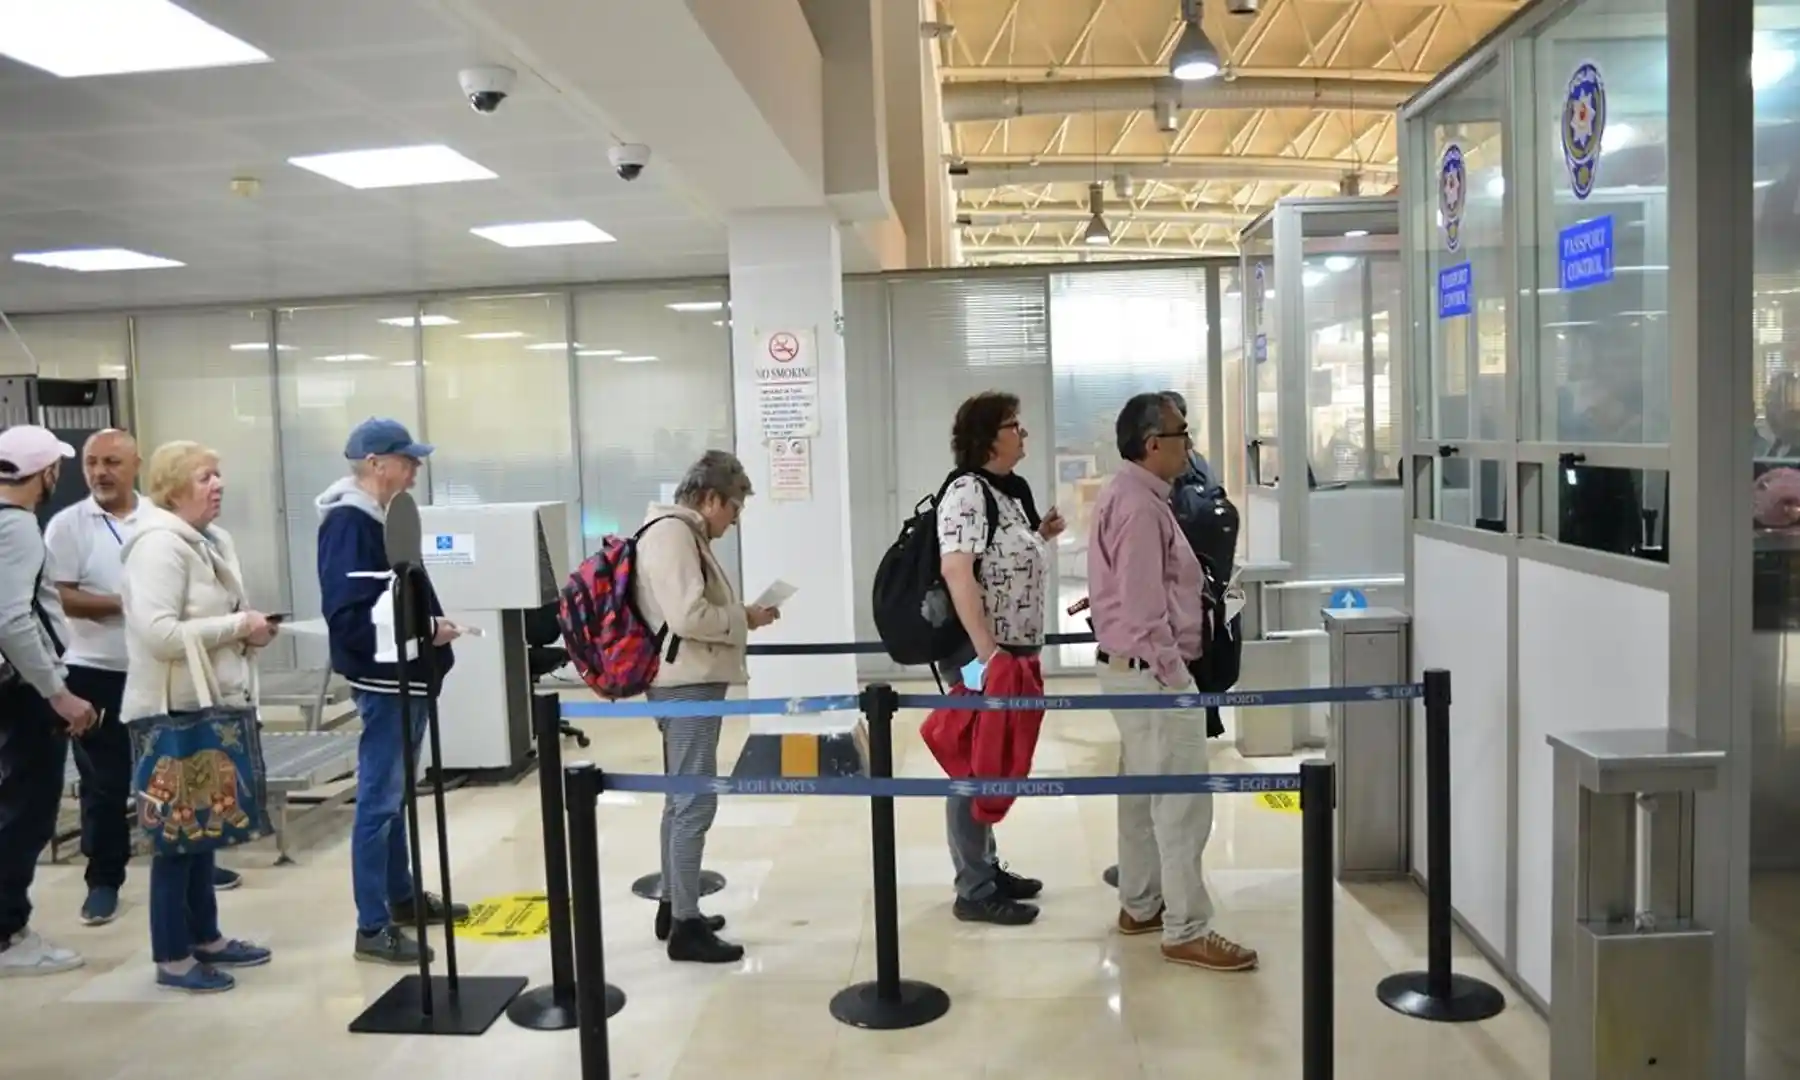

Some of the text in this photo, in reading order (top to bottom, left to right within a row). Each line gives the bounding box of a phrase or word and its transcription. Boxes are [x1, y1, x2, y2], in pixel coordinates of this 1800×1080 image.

[1563, 227, 1606, 258] PASSPORT
[1567, 254, 1604, 281] CONTROL
[756, 368, 770, 378] NO
[769, 779, 817, 793] PORTS
[1015, 781, 1065, 795] PORTS
[1240, 777, 1270, 792] EGE
